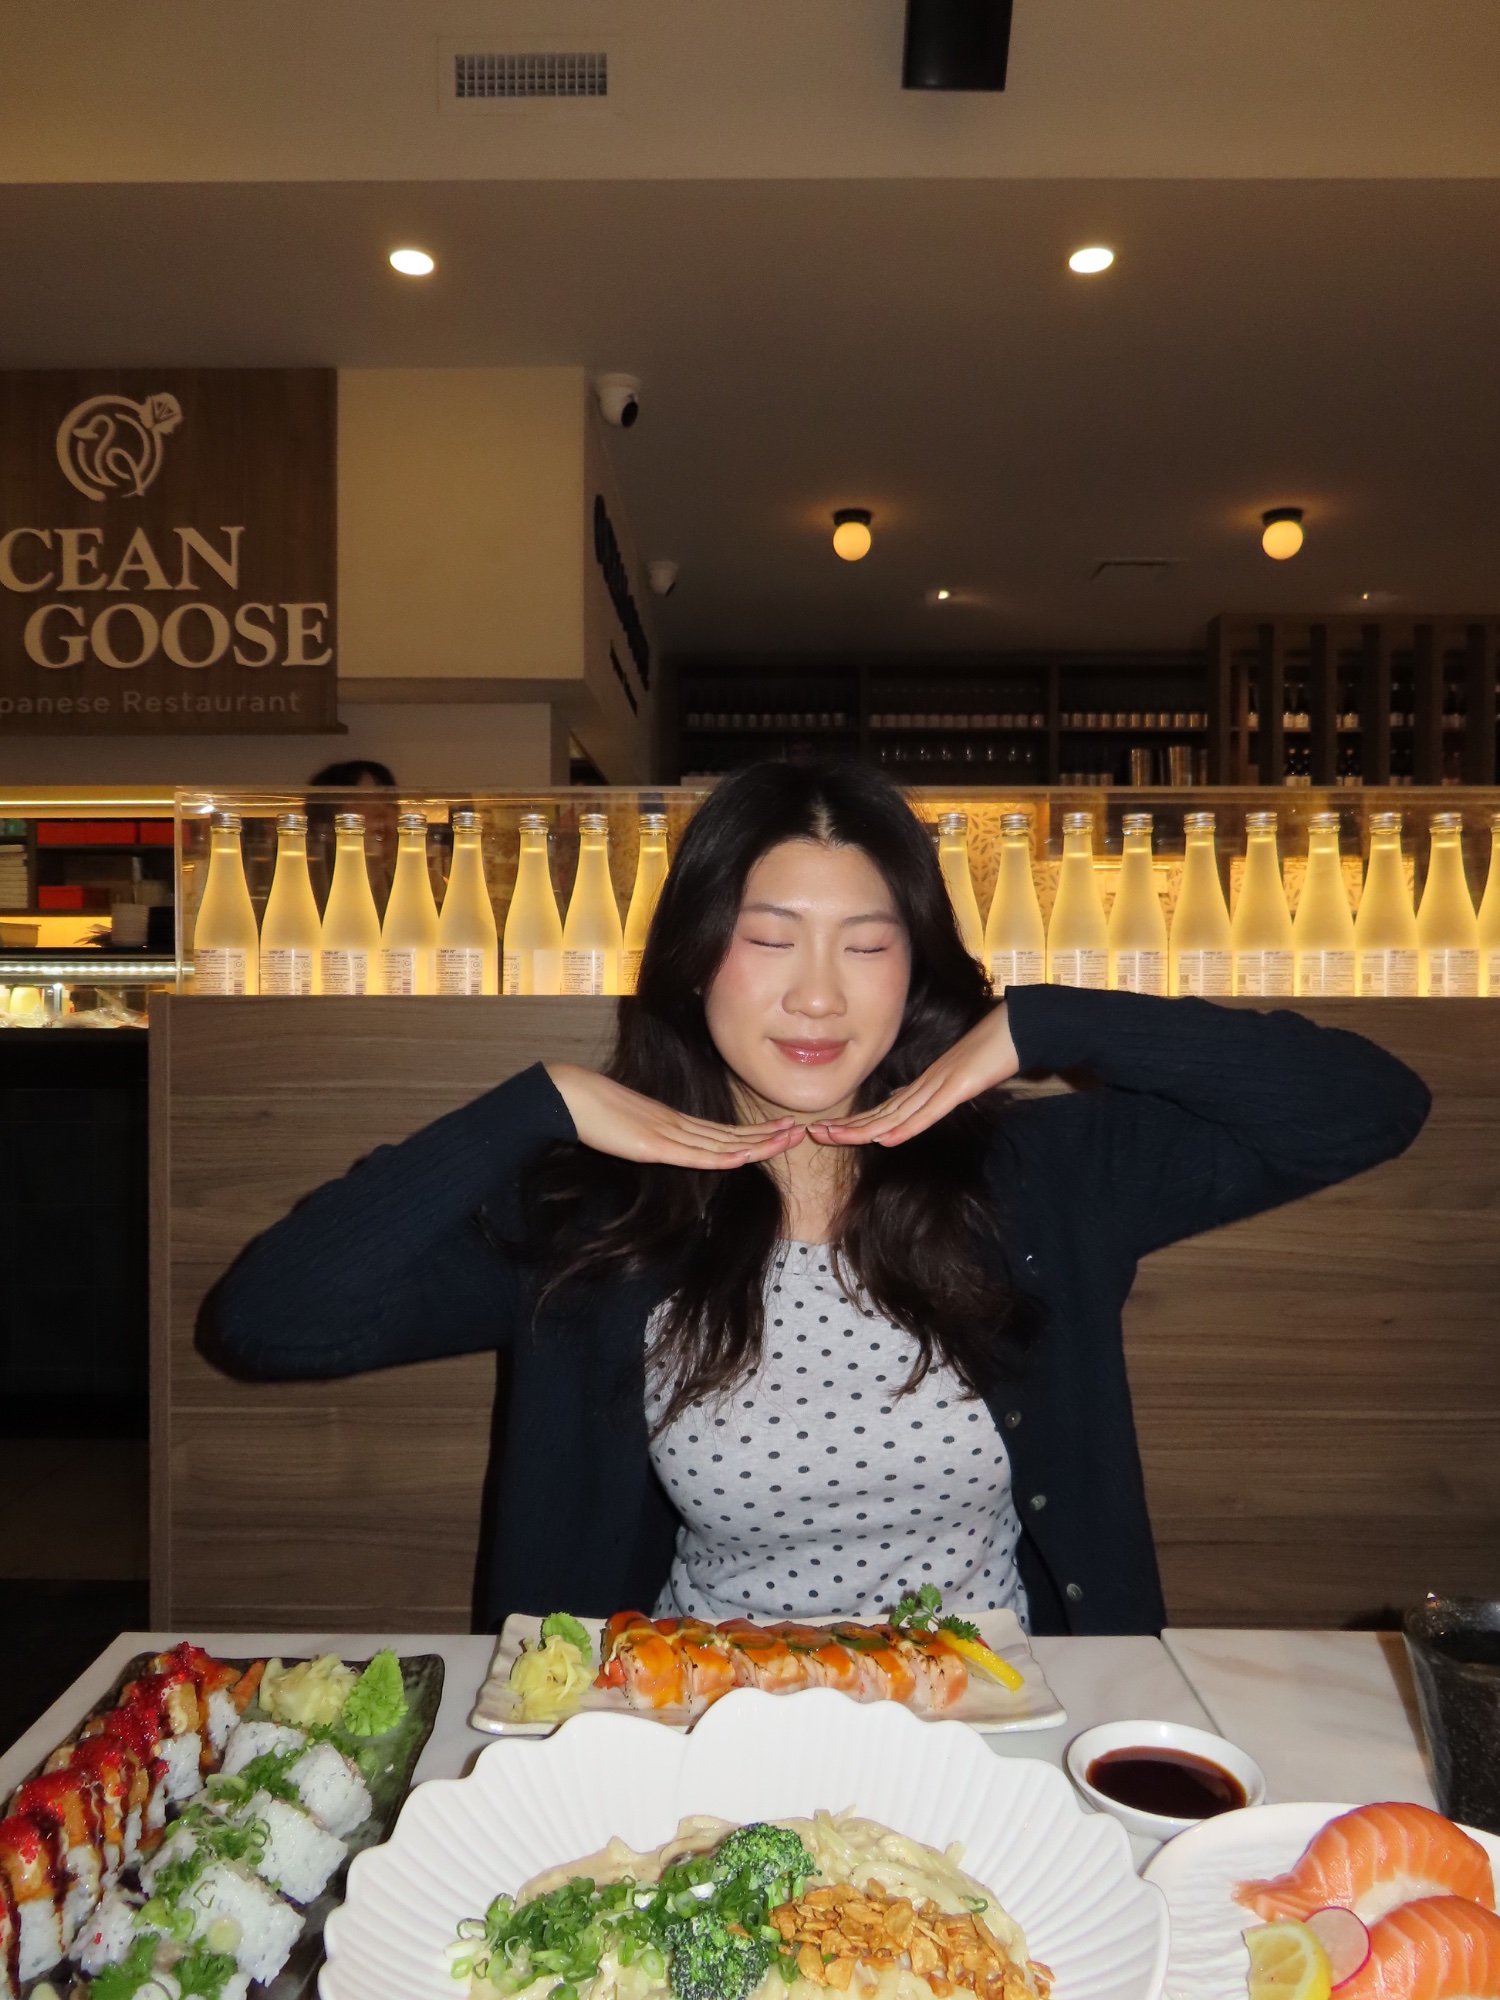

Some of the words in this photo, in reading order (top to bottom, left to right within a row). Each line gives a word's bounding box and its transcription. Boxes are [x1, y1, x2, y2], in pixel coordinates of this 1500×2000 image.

[0, 526, 245, 592] CEAN
[24, 602, 332, 669] GOOSE
[123, 691, 301, 714] Restaurant
